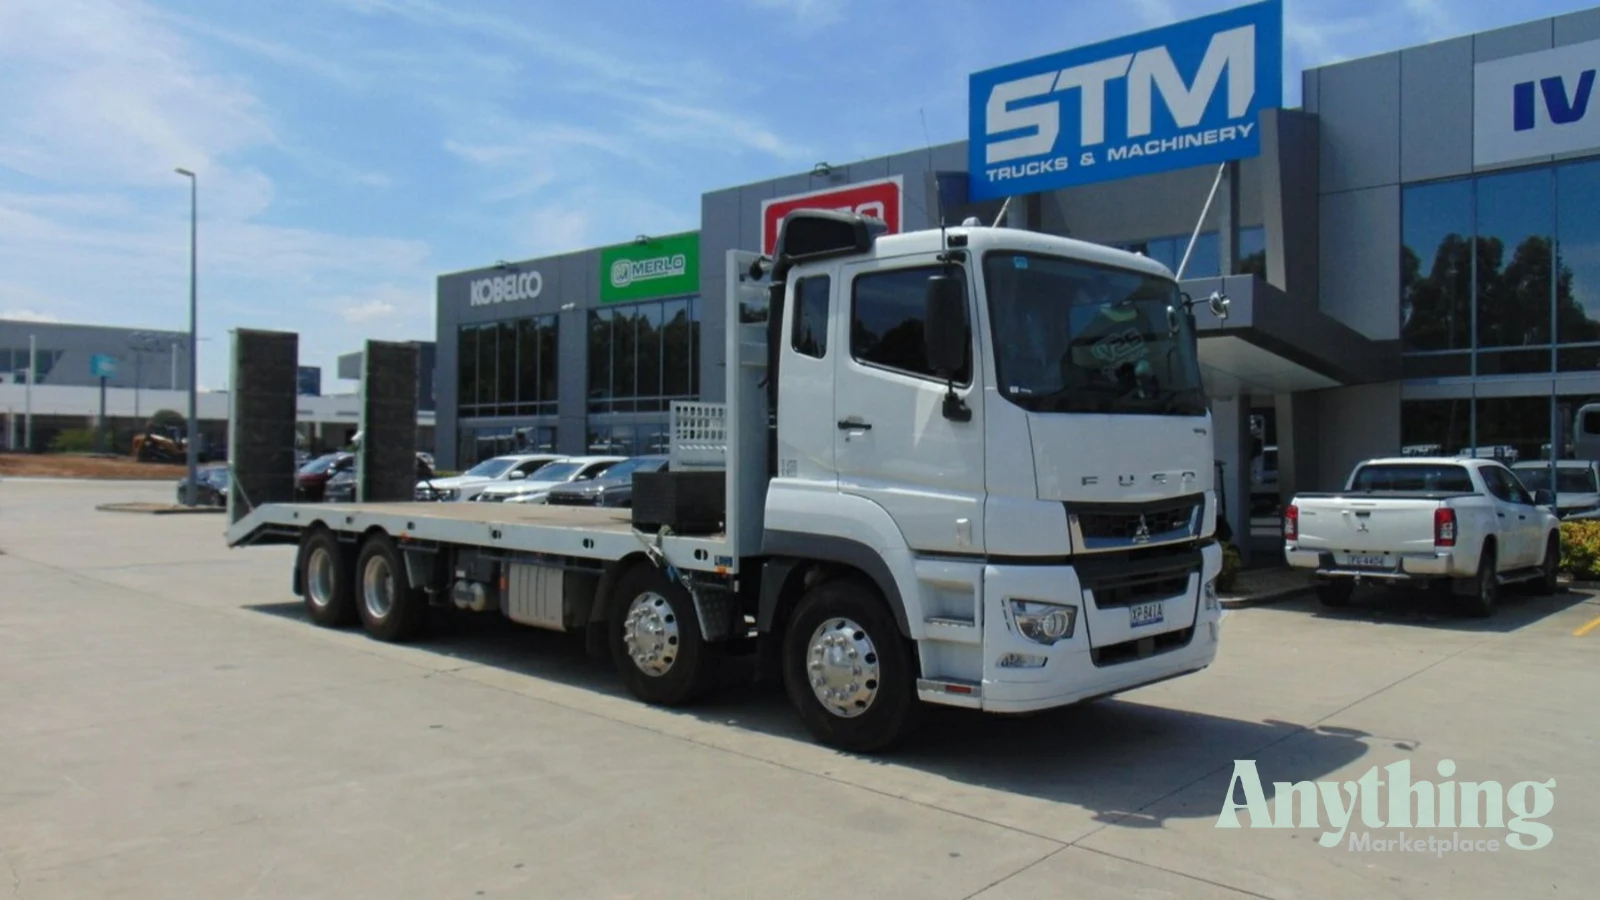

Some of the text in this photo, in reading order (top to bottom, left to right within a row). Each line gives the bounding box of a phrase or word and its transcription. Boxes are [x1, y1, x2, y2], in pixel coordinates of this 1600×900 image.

[986, 24, 1255, 164] STM
[1513, 68, 1597, 132] IV
[986, 123, 1254, 182] TRUCKS & MACHINERY
[470, 271, 542, 306] KOBELCO
[632, 254, 685, 276] MERLO
[1081, 471, 1196, 487] FUSO
